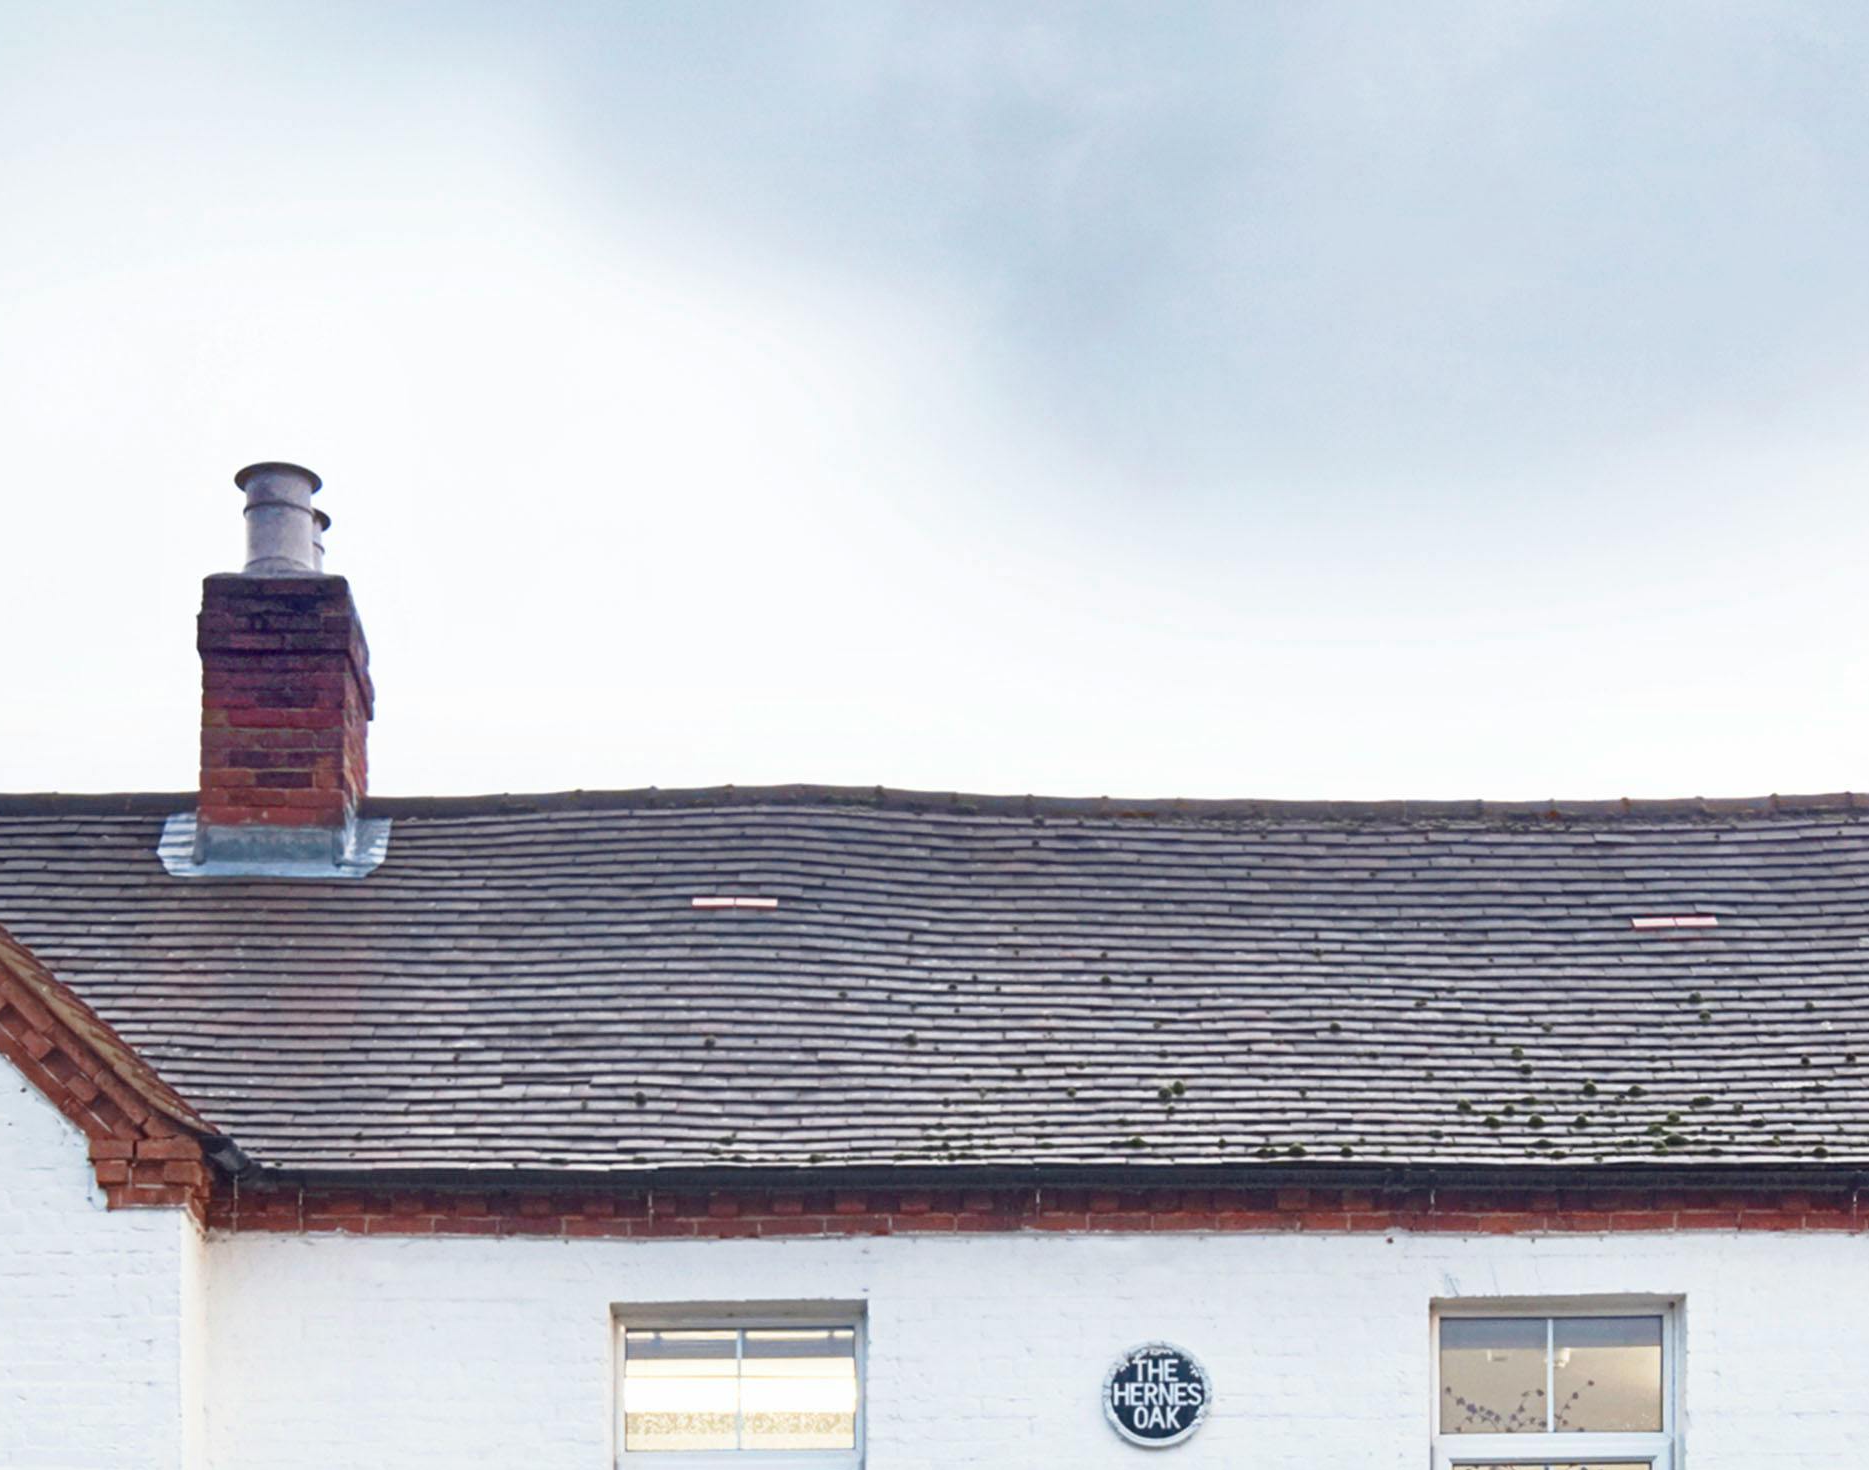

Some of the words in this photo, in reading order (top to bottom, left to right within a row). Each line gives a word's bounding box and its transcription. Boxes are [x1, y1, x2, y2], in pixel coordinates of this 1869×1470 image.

[1132, 1359, 1179, 1382] THE
[1113, 1382, 1203, 1406] HERNES
[1133, 1406, 1181, 1429] OAK
